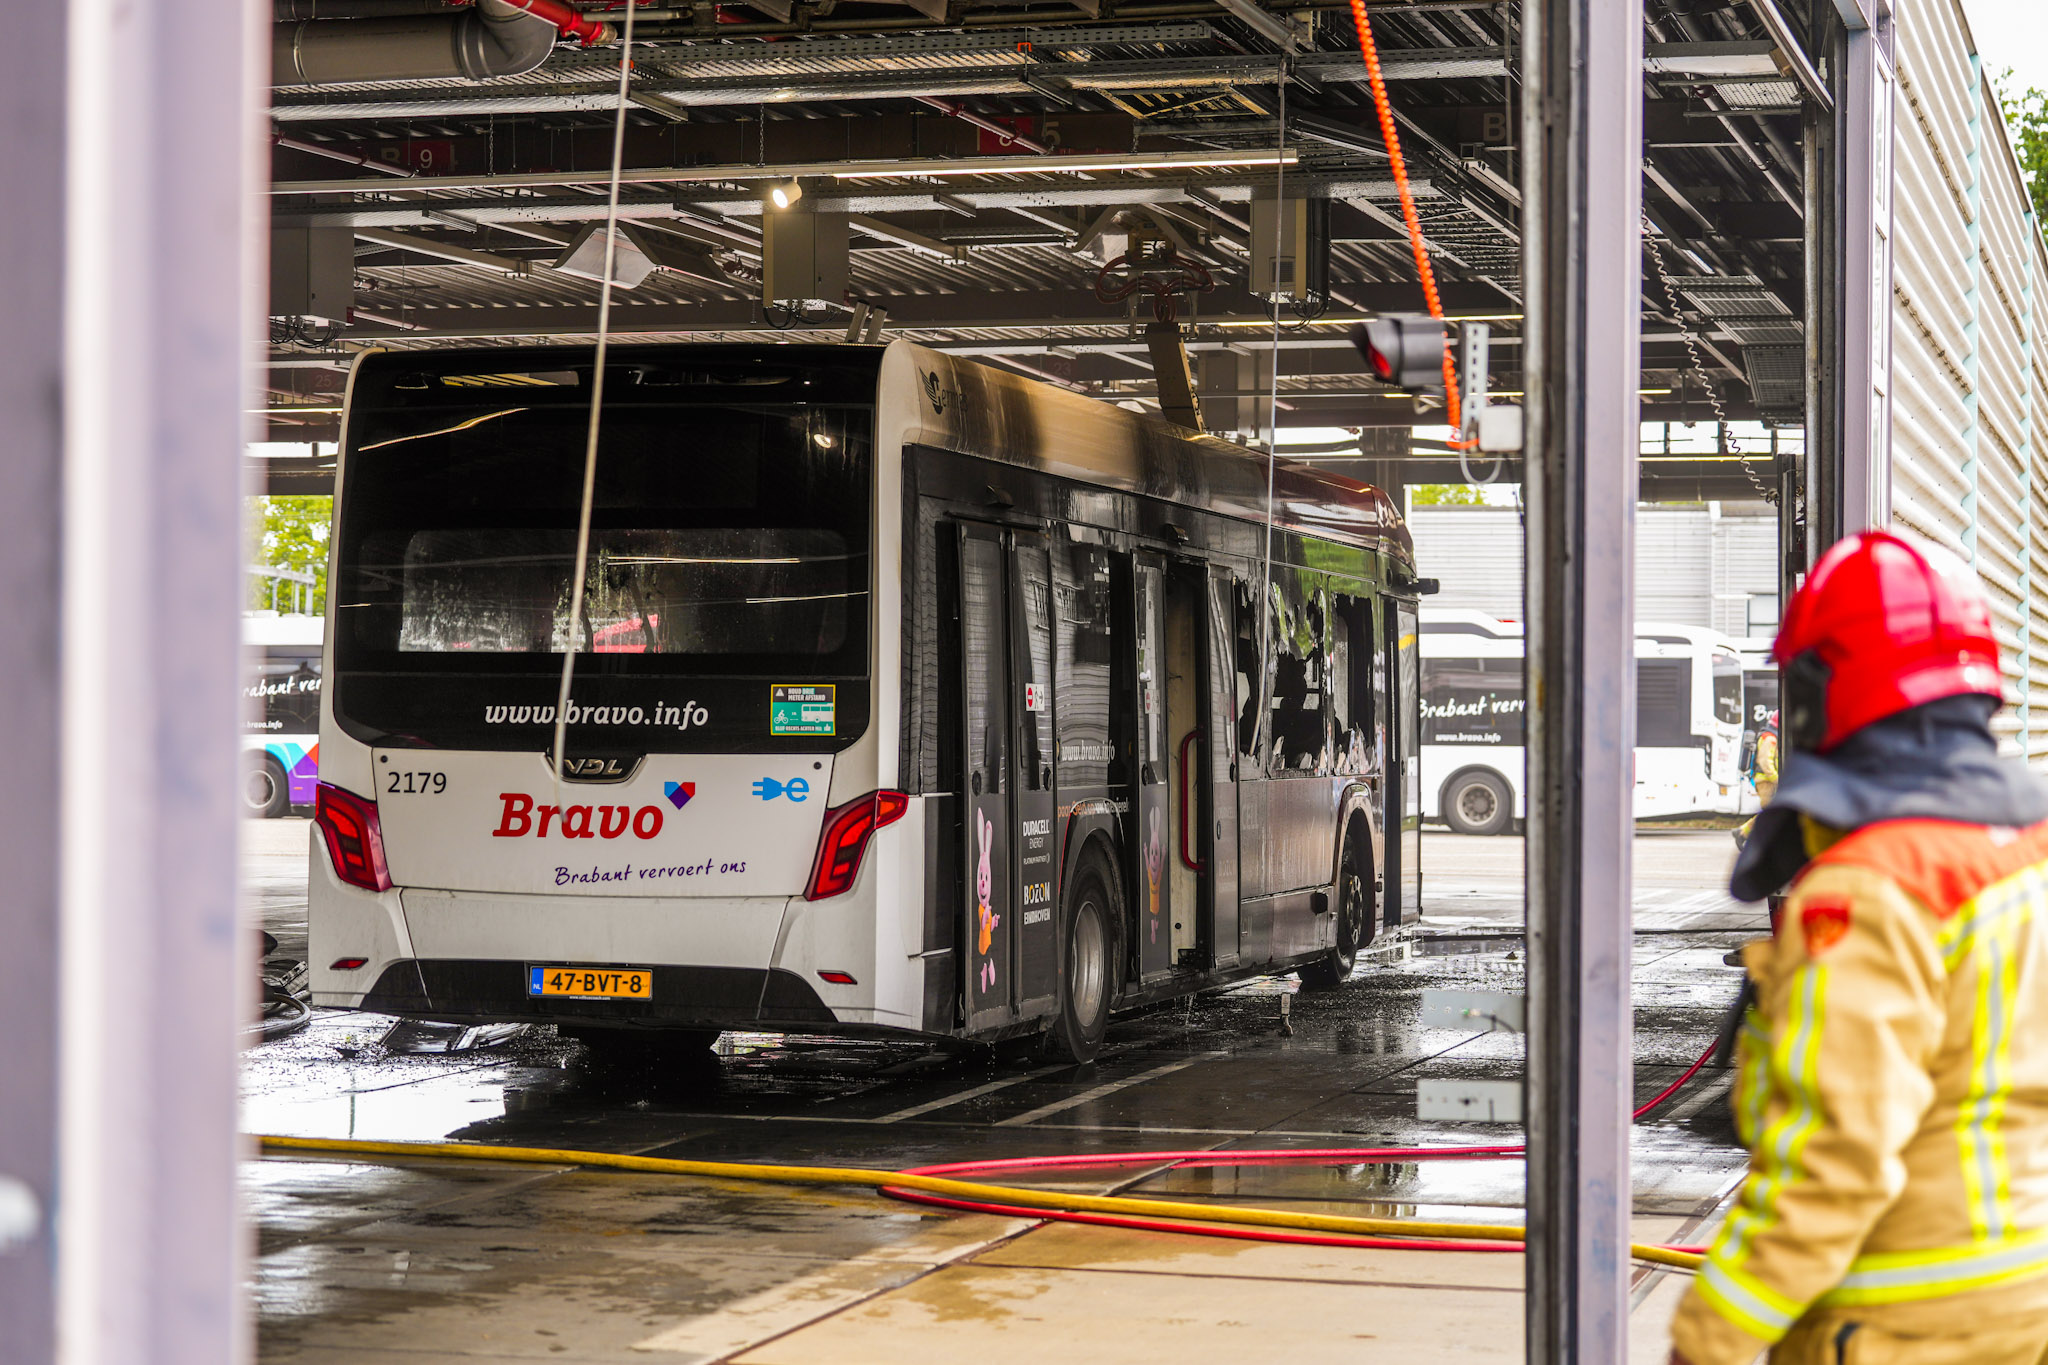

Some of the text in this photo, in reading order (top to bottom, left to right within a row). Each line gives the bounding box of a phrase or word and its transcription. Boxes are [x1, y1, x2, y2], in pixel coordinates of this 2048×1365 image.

[1483, 112, 1506, 142] B
[420, 148, 433, 169] 9
[243, 675, 322, 697] rabant ver
[787, 694, 805, 702] METER
[1491, 699, 1526, 714] verv
[485, 699, 709, 731] www.bravo.info
[1435, 732, 1502, 744] www.bravo.info
[1061, 739, 1116, 765] www.bravo.info
[387, 771, 447, 794] 2179
[492, 792, 664, 840] Bravo
[1022, 818, 1050, 837] DURACELL
[1028, 836, 1044, 850] ENERGY
[554, 858, 747, 886] Brabant vervoert ons
[1023, 881, 1051, 906] BOZON
[1023, 907, 1051, 926] EINDHOVEN
[550, 972, 642, 994] 47-BVT-8
